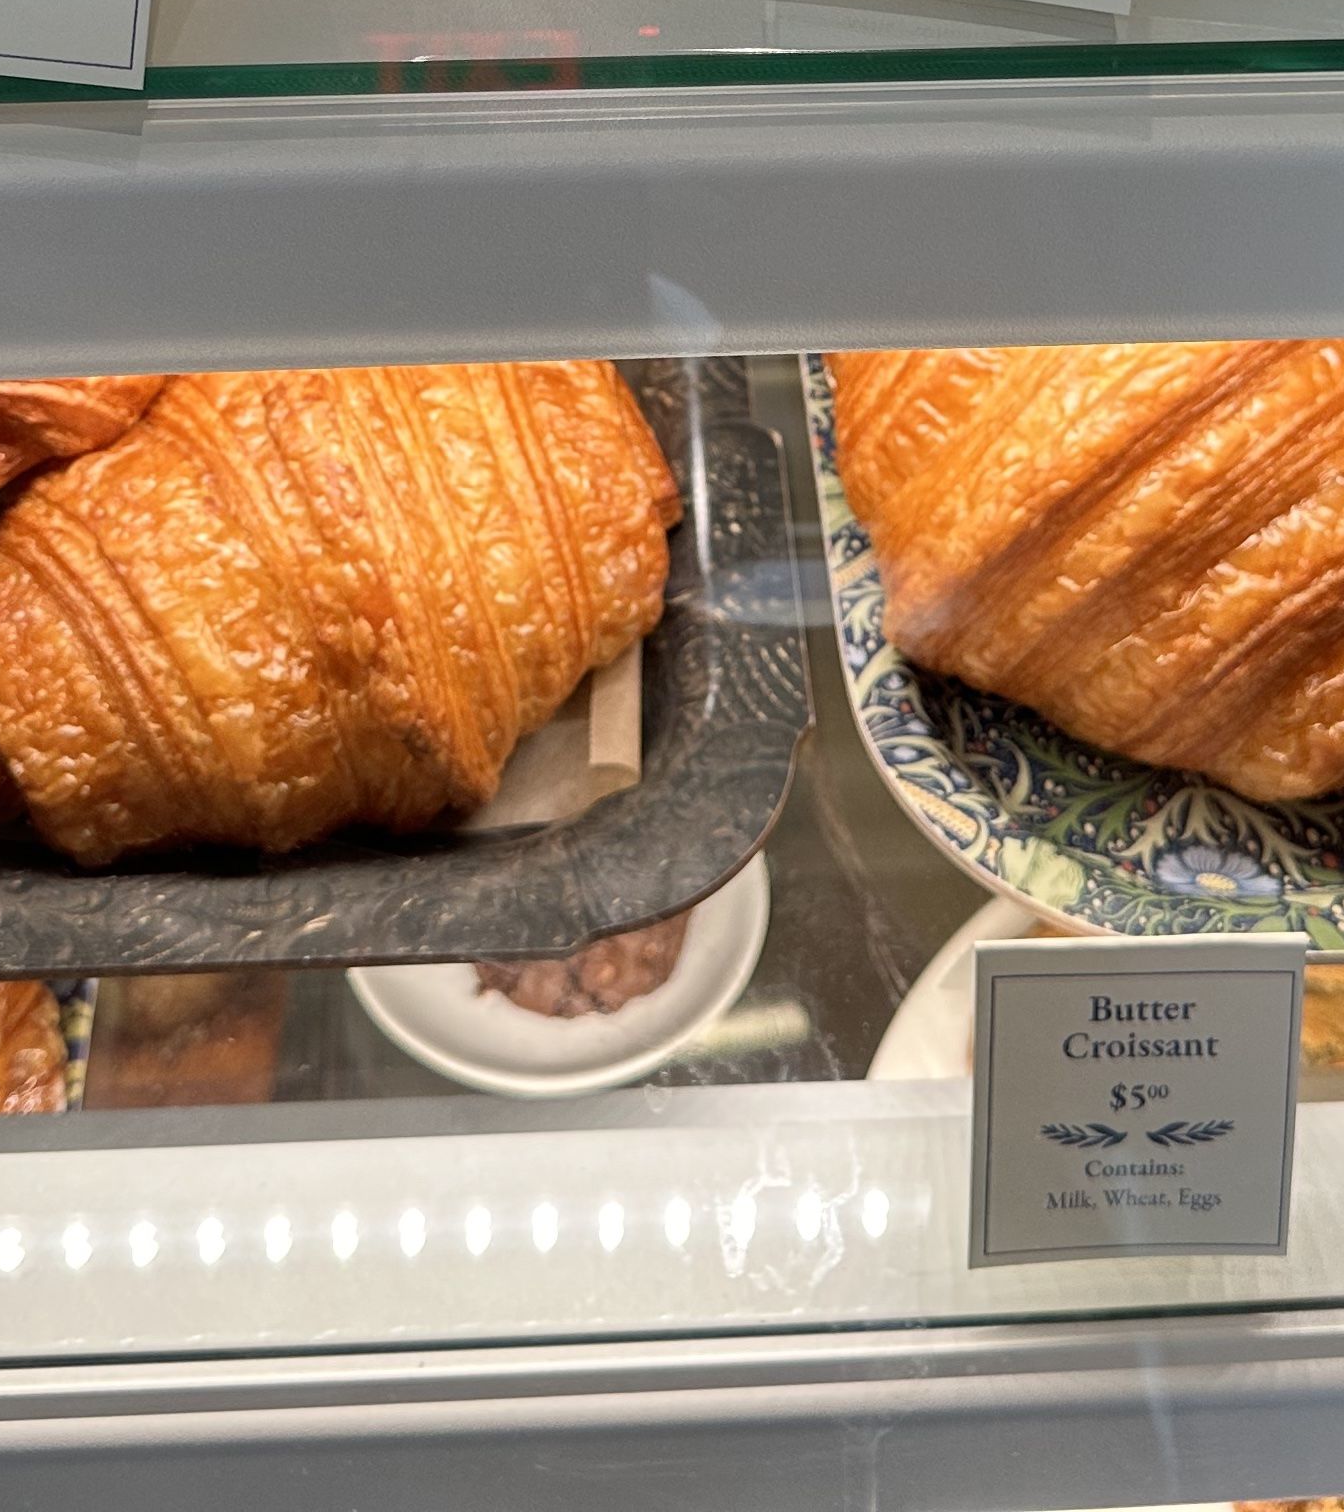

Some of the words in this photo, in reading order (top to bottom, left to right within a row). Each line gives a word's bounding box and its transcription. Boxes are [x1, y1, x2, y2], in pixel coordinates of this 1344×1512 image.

[1089, 995, 1197, 1023] Butter
[1062, 1031, 1219, 1060] Croissant
[1084, 1158, 1185, 1179] Contains:
[1046, 1189, 1097, 1211] Milk,
[1102, 1188, 1173, 1209] Wheat,
[1178, 1187, 1223, 1213] Eggs
